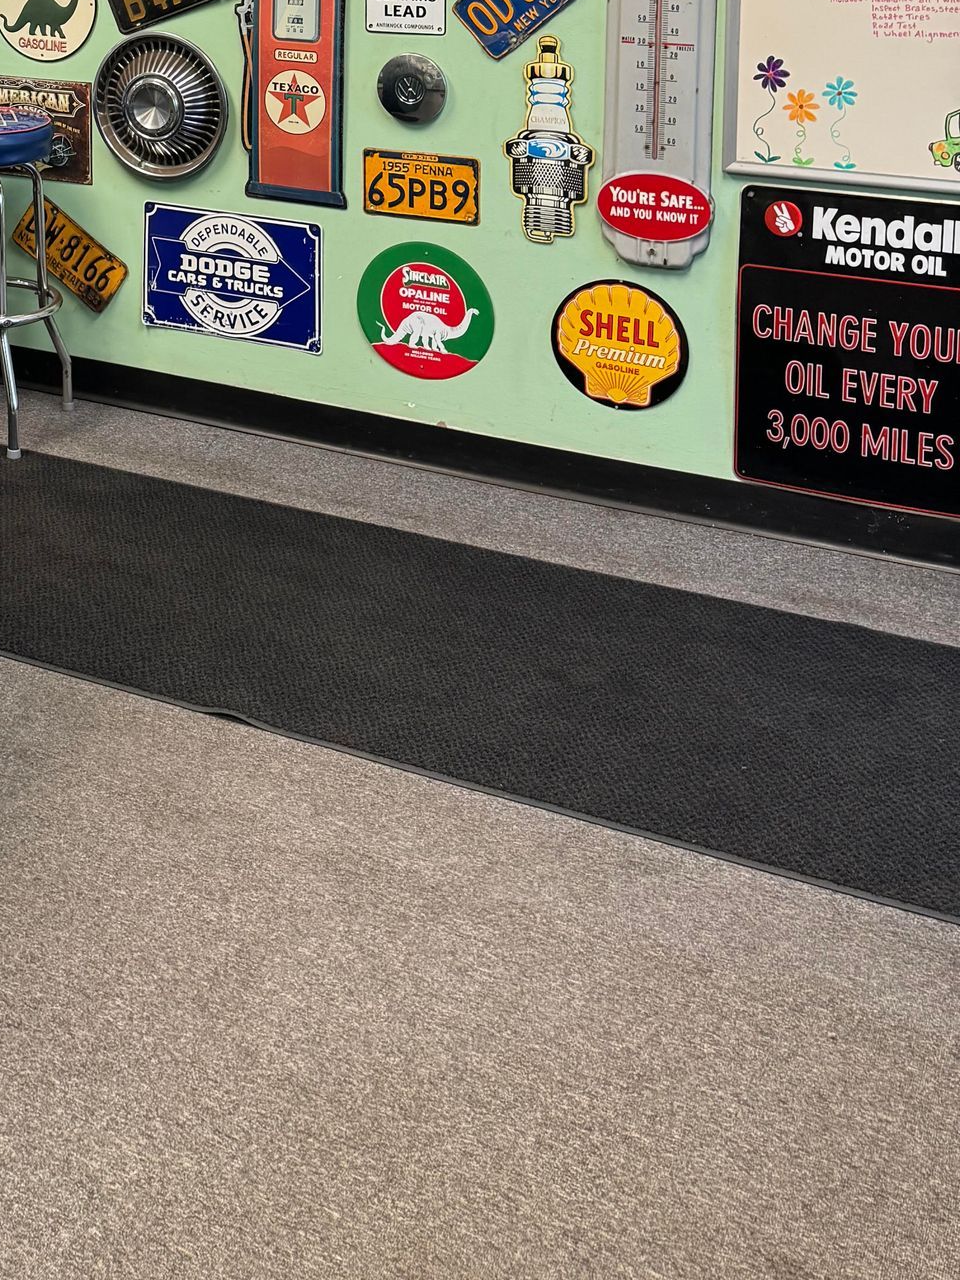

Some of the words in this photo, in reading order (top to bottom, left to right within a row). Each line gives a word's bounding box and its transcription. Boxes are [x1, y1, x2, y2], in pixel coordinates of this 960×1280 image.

[384, 5, 427, 18] LEAD
[513, 5, 539, 31] NEW
[871, 4, 901, 12] Inspect
[872, 13, 903, 21] Rotate
[906, 13, 930, 21] Tires
[403, 23, 434, 31] COMPOUNDS
[18, 37, 68, 53] GASOLINE
[277, 51, 315, 61] REGULAR
[271, 82, 319, 95] TEXACO
[530, 115, 567, 125] CHAMPION
[382, 161, 410, 173] 1955
[414, 164, 453, 177] PENNA
[368, 171, 470, 214] 65PB9
[609, 185, 655, 206] YOU'RE
[660, 191, 705, 211] SAFE...
[610, 206, 630, 217] AND
[633, 208, 652, 220] YOU
[656, 210, 686, 224] KNOW
[689, 214, 699, 225] IT
[192, 223, 269, 258] DEPENDABLE
[811, 205, 960, 255] Kendall
[180, 254, 271, 284] DODGE
[824, 245, 906, 274] MOTOR
[911, 253, 947, 277] OIL
[168, 270, 207, 286] CARS
[212, 277, 222, 288] &
[225, 279, 284, 298] TRUCKS
[402, 266, 449, 289] SINCLAIR
[399, 287, 450, 304] OPALINE
[190, 294, 269, 329] SERVICE
[402, 301, 432, 313] MOTOR
[434, 305, 447, 316] OIL
[579, 309, 660, 349] SHELL
[752, 303, 877, 354] CHANGE
[572, 337, 667, 370] Premium
[595, 360, 640, 376] GASOLINE
[785, 360, 830, 400] OIL
[841, 367, 939, 415] EVERY
[765, 409, 850, 454] 3,000
[860, 423, 955, 471] MILES
